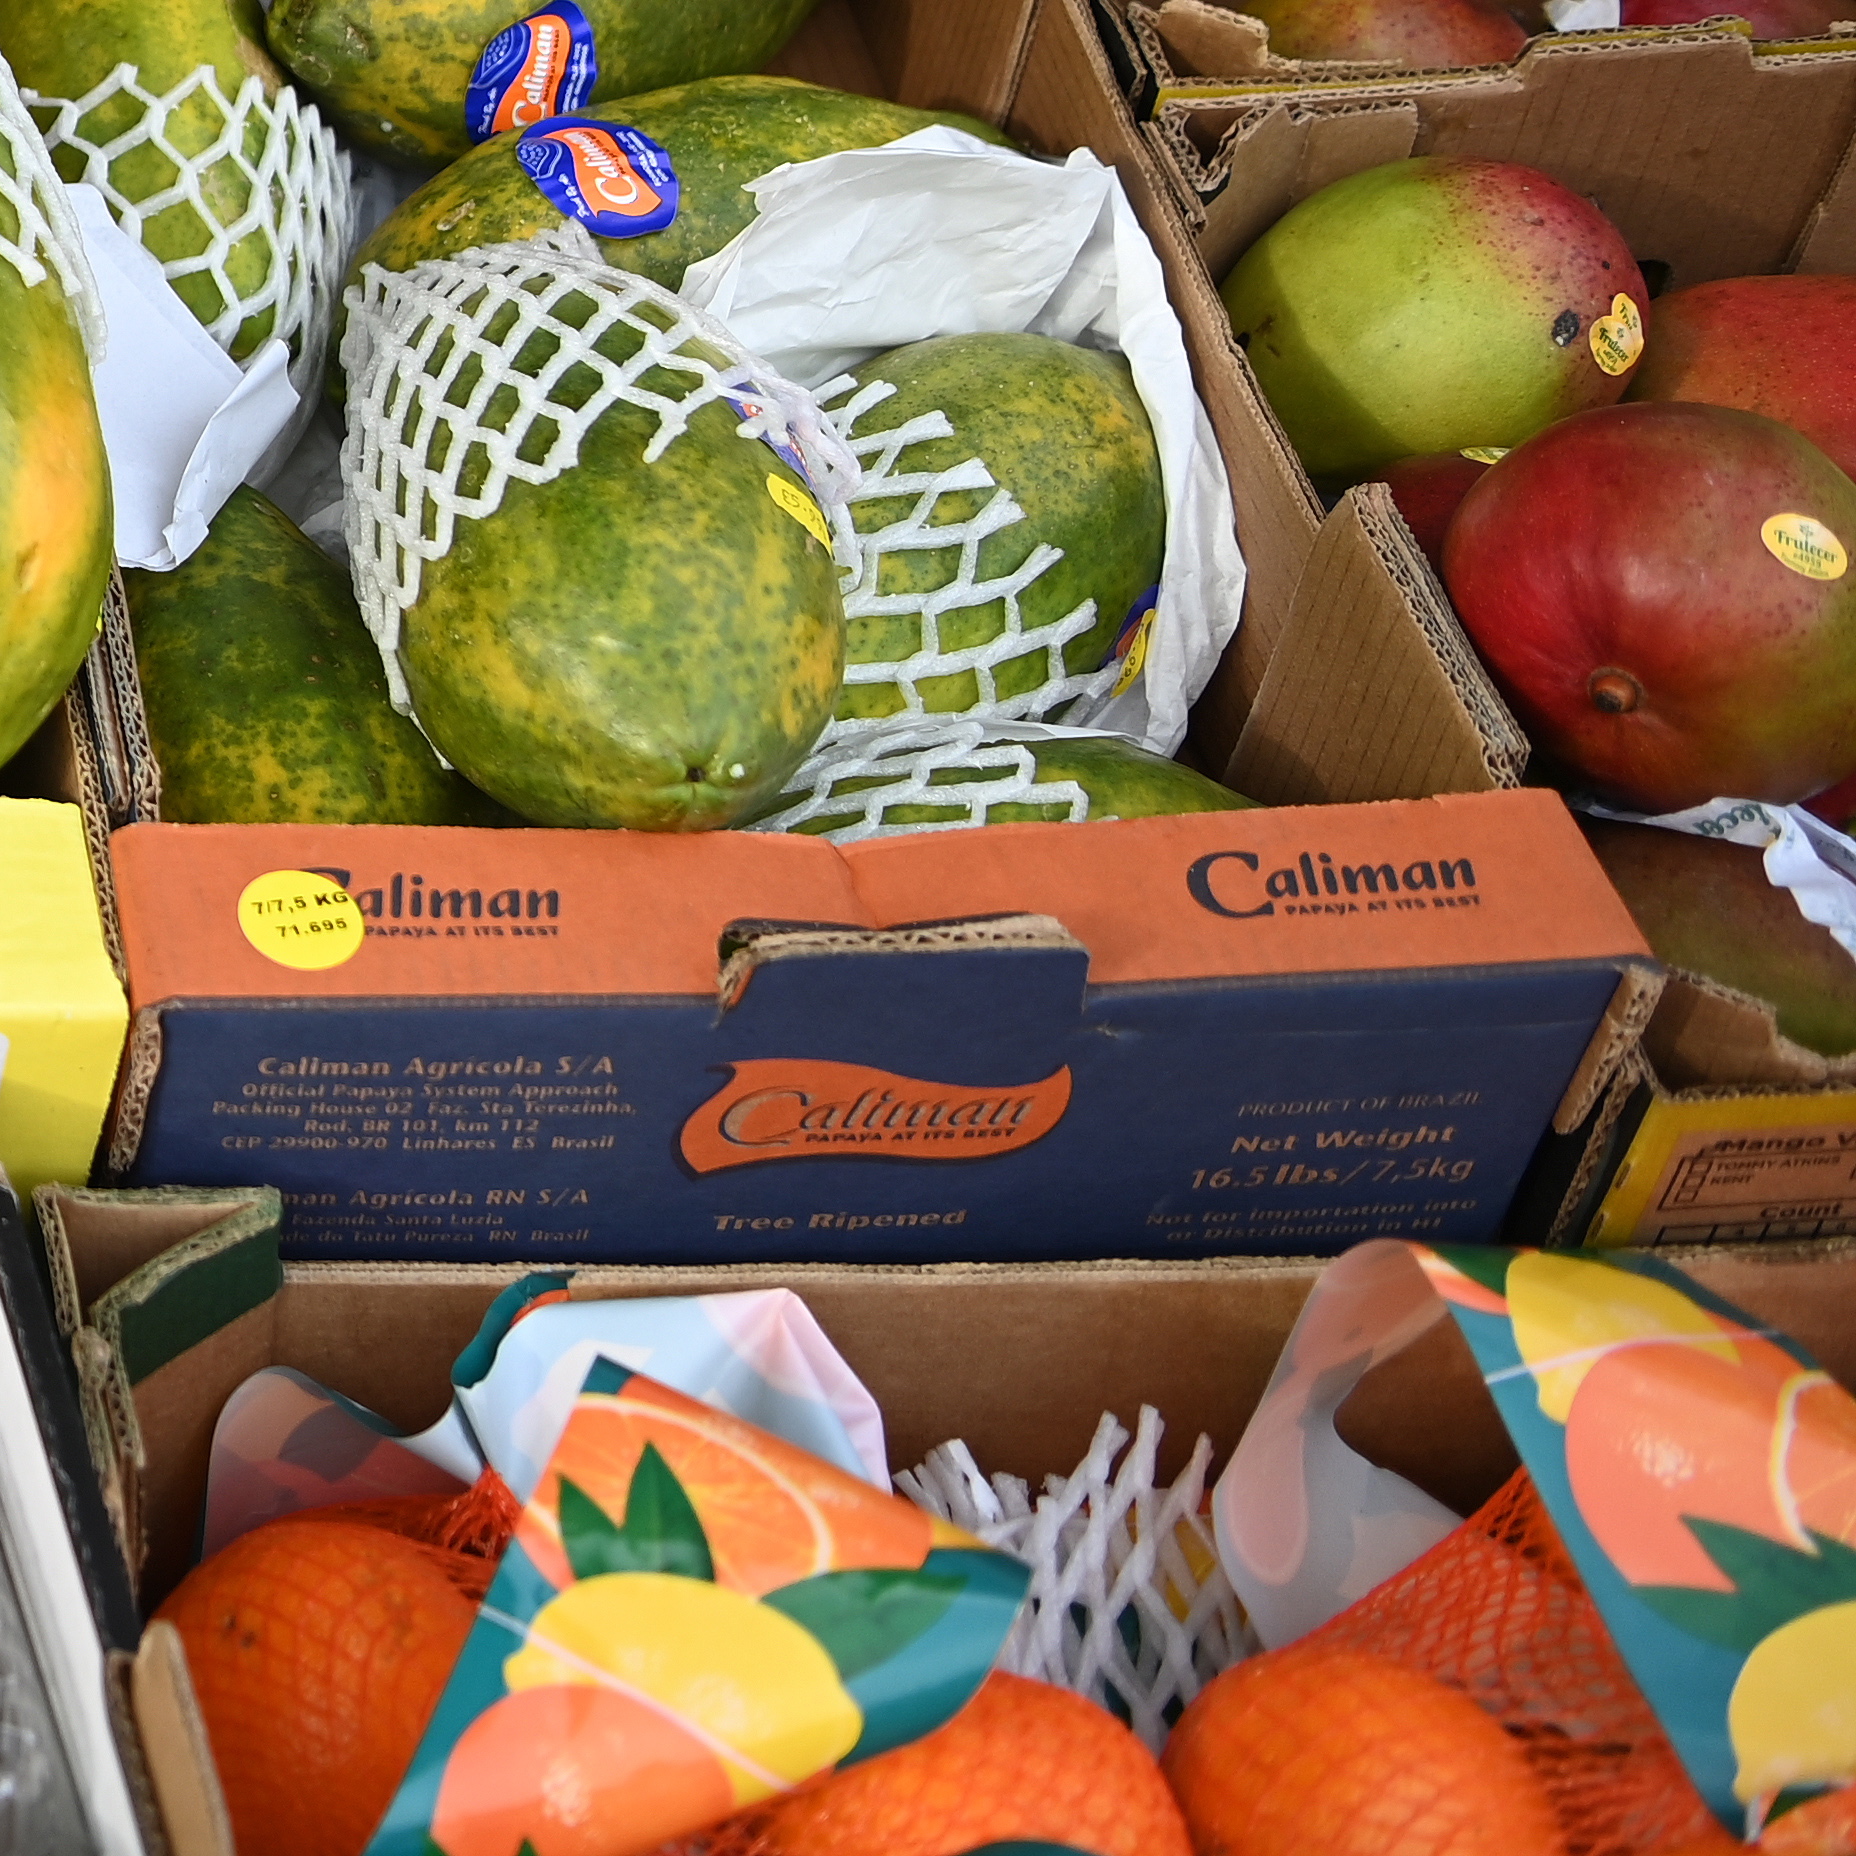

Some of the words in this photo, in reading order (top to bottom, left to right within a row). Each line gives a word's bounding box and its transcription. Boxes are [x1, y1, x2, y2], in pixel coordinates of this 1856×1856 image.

[563, 129, 639, 205] Caliman
[1187, 849, 1478, 919] Caliman
[314, 890, 350, 909] KG
[1285, 898, 1362, 916] PAPAYA
[1368, 898, 1388, 913] AT
[1426, 894, 1480, 910] BEST
[445, 924, 468, 937] AT
[511, 923, 559, 937] BEST
[257, 1056, 390, 1077] Caliman
[554, 1055, 615, 1077] S/A
[241, 1081, 325, 1099] Official
[332, 1082, 414, 1101] Papaya
[419, 1081, 501, 1101] System
[507, 1081, 619, 1101] Approach
[212, 1100, 301, 1118] Packing
[309, 1100, 378, 1117] House
[716, 1084, 1036, 1147] Caliman
[361, 1117, 393, 1134] BR
[454, 1117, 490, 1133] km
[805, 1128, 887, 1145] PAPAYA
[892, 1128, 916, 1144] AT
[961, 1125, 1017, 1141] BEST
[550, 1133, 617, 1151] Brasil
[1231, 1132, 1298, 1154] Net
[1313, 1121, 1457, 1151] Weight
[484, 1189, 526, 1206] RN
[537, 1188, 589, 1207] S/A
[711, 1214, 796, 1234] Tree
[807, 1207, 968, 1234] Ripened
